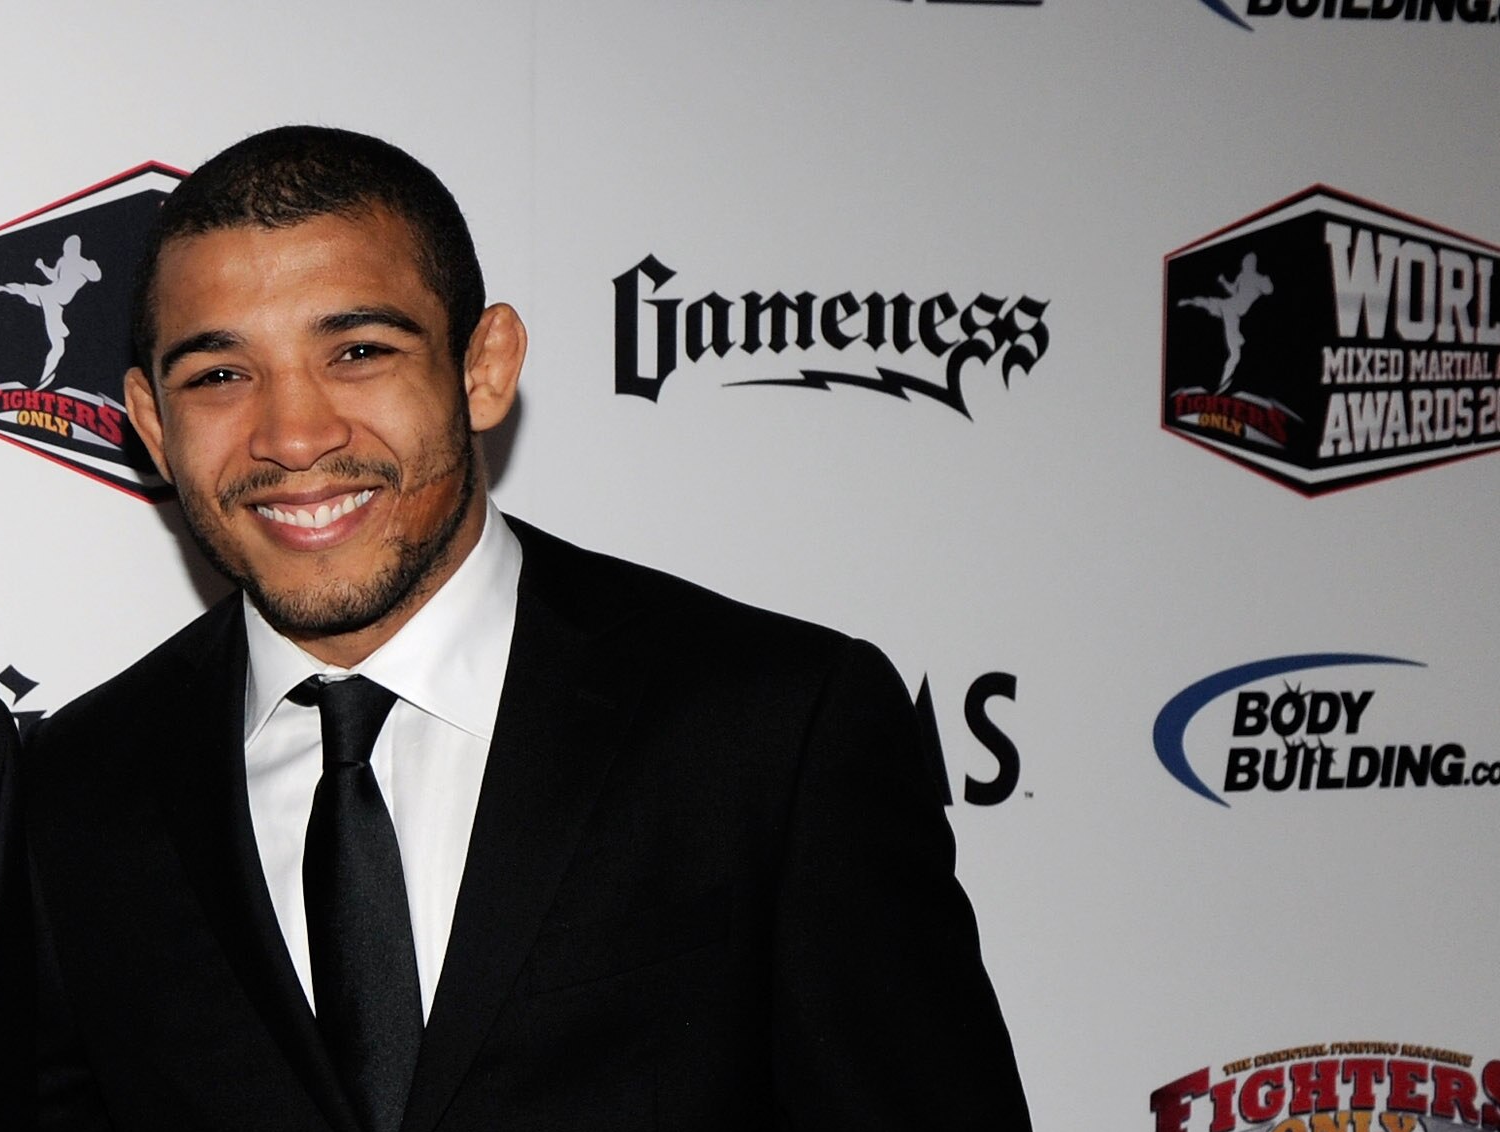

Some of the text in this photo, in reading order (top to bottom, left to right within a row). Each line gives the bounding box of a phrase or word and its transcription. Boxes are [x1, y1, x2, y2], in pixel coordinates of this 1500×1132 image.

[1323, 220, 1500, 346] WORL
[611, 253, 1051, 422] Gameness
[1321, 346, 1404, 384] MIXED
[1408, 349, 1492, 383] MARTIAL
[18, 411, 70, 437] ONLY
[1199, 412, 1243, 437] ONLY
[1318, 385, 1500, 458] AWARDS 2
[1233, 688, 1375, 737] BODY
[1223, 1058, 1252, 1076] THE
